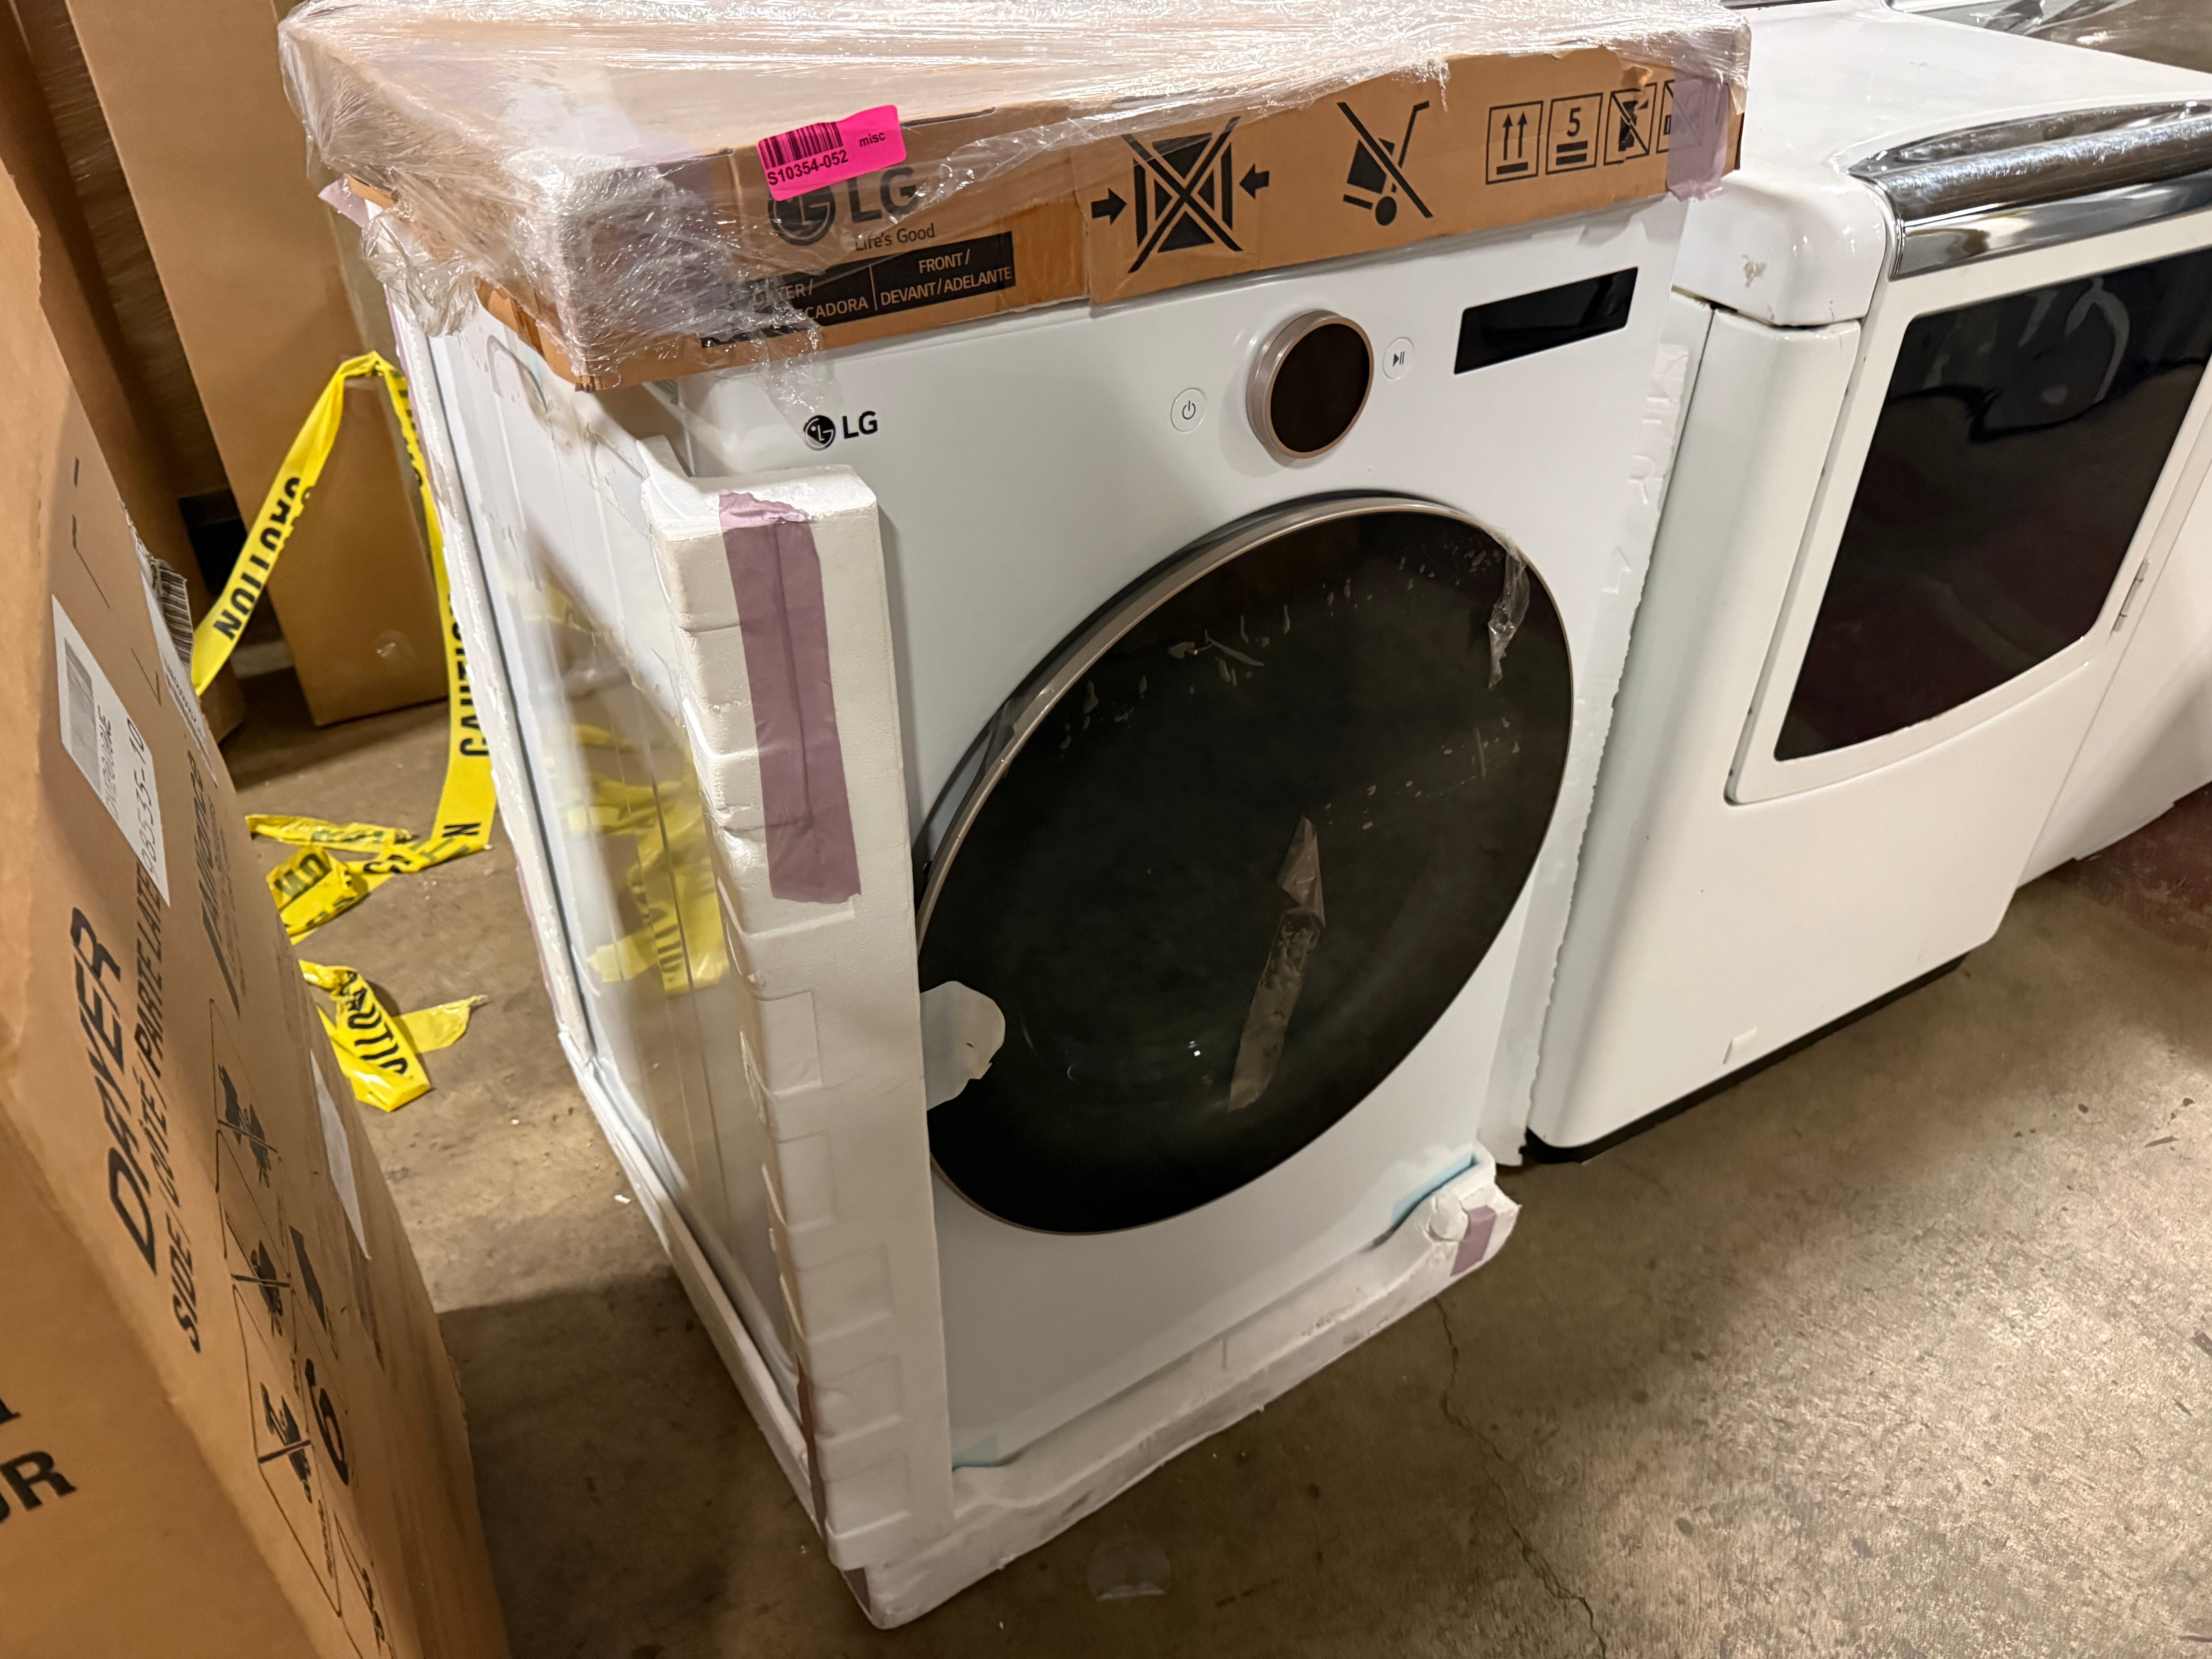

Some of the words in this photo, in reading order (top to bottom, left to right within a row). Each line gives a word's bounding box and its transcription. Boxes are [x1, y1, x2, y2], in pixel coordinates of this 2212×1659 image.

[1567, 107, 1581, 137] 5
[859, 132, 886, 148] misc
[767, 149, 849, 186] S10354-052
[847, 167, 919, 223] LG
[896, 223, 935, 244] Good
[842, 410, 878, 440] LG
[137, 860, 162, 963] LATE
[70, 907, 157, 1276] DRYER
